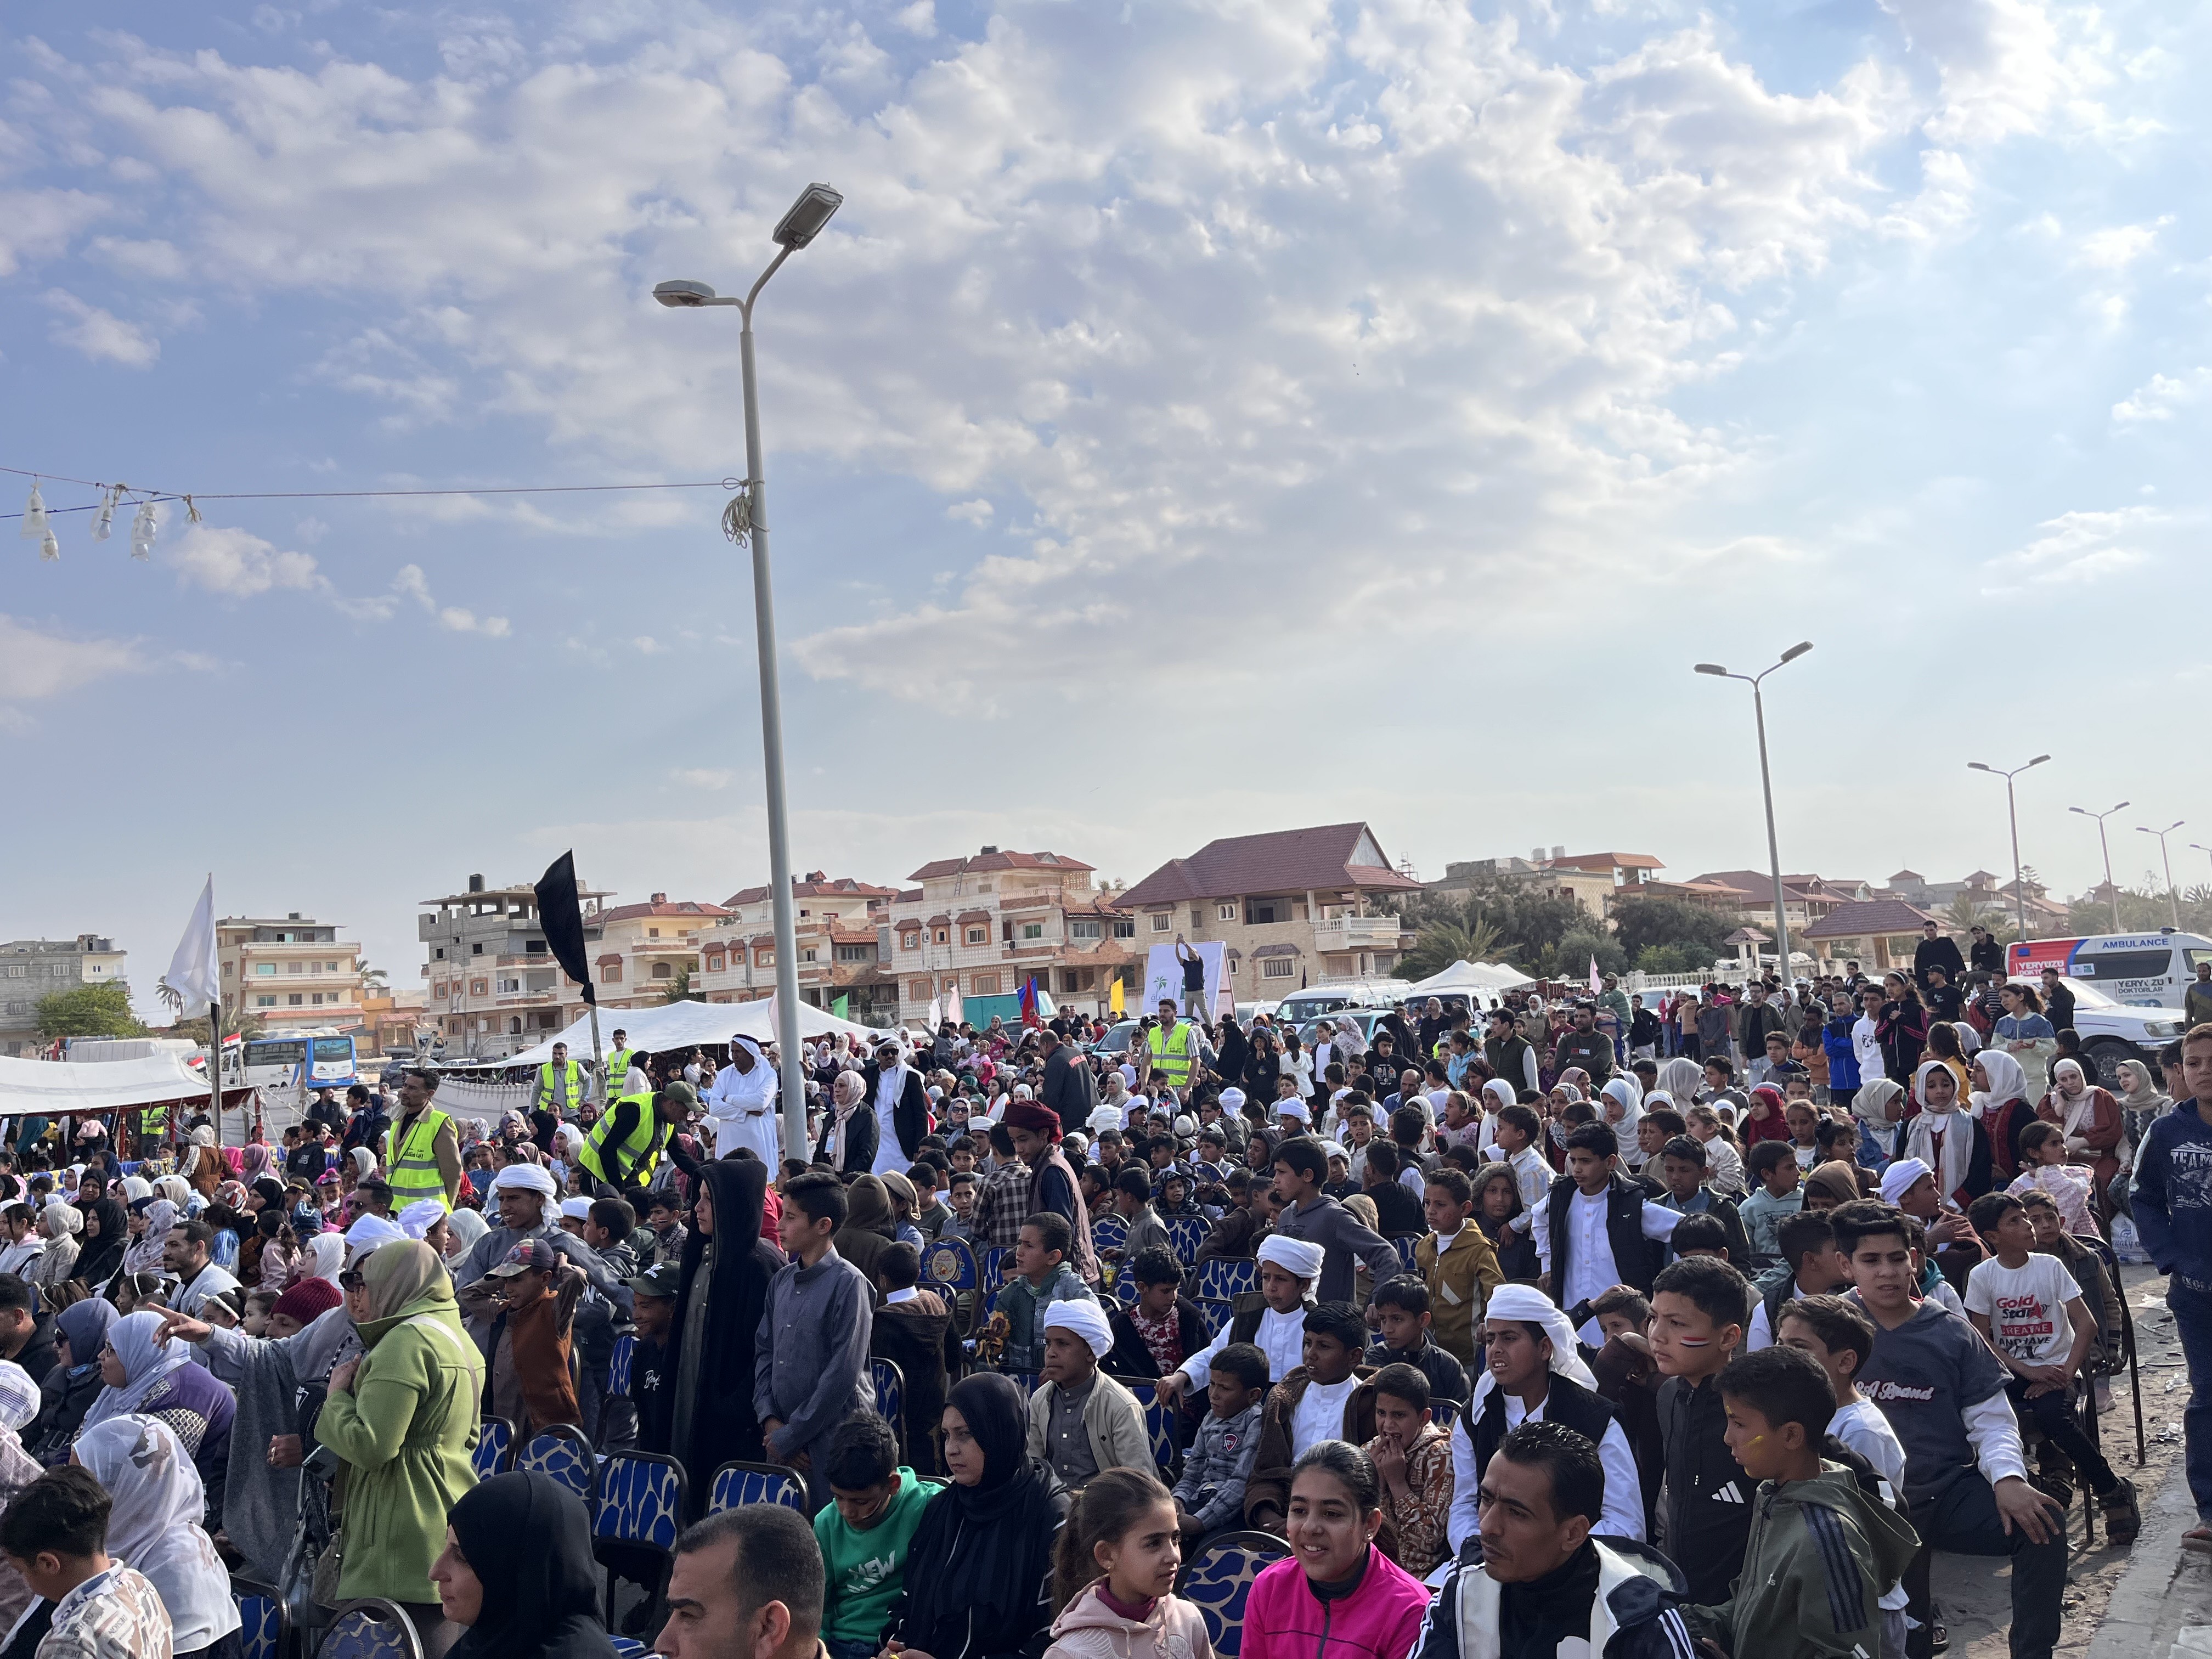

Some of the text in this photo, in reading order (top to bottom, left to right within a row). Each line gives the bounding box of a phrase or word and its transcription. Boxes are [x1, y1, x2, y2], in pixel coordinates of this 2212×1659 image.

[2102, 938, 2169, 949] AMBULANCE
[1996, 1295, 2034, 1308] Gold
[2002, 1308, 2035, 1319] Star
[1878, 1381, 1934, 1400] Brand
